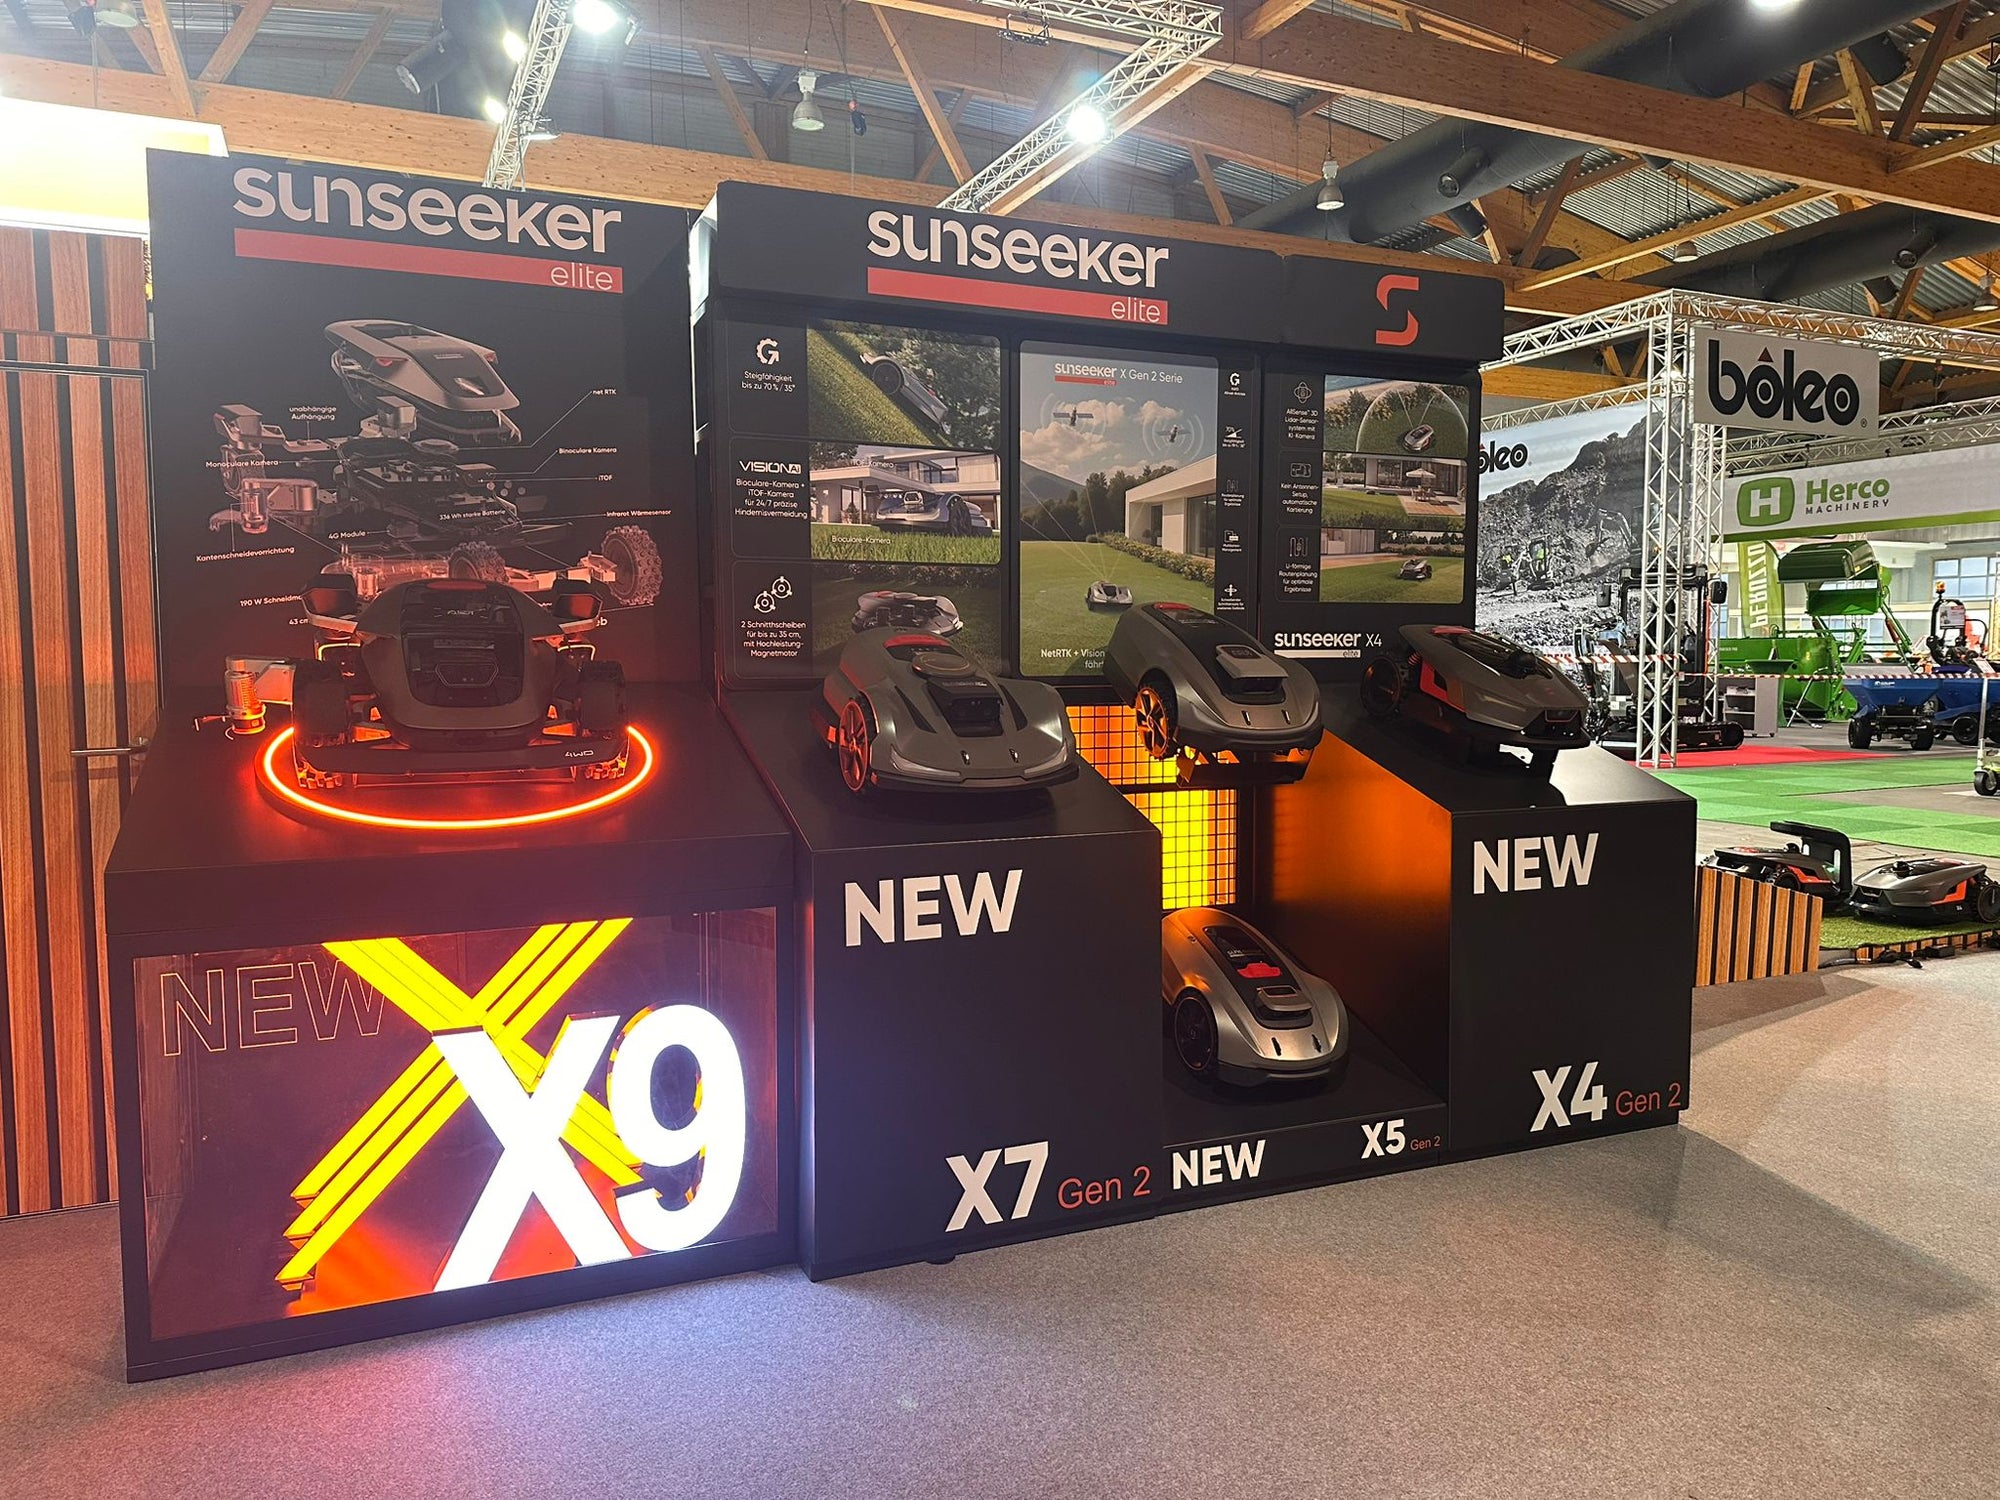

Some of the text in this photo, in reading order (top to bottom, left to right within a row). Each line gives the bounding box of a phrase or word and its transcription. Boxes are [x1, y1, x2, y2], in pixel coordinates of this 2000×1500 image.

[232, 167, 622, 253] sunseeker
[867, 210, 1169, 288] sunseeker
[550, 262, 613, 291] elite
[1111, 297, 1160, 322] elite
[741, 381, 752, 389] bis
[1054, 363, 1183, 384] sunseeker X Gen 2 Serie
[745, 498, 755, 506] für
[756, 499, 773, 508] 24/7
[1805, 478, 1890, 505] Herco
[1805, 499, 1890, 515] MACHINERY
[340, 530, 366, 538] Module
[240, 599, 253, 607] 190
[740, 620, 746, 628] 2
[746, 630, 756, 638] für
[1274, 633, 1382, 647] sunseeker X4
[1041, 649, 1072, 658] NetRTK
[1080, 649, 1106, 658] Vision
[565, 750, 594, 758] 4WD
[1473, 833, 1599, 894] NEW
[845, 869, 1023, 947] NEW
[160, 961, 387, 1057] NEW
[1530, 1061, 1681, 1132] X4 Gen 2
[432, 1004, 746, 1292] X9
[1361, 1119, 1440, 1159] X5 Gen 2
[1172, 1139, 1266, 1190] NEW
[945, 1141, 1151, 1232] X7 Gen 2
